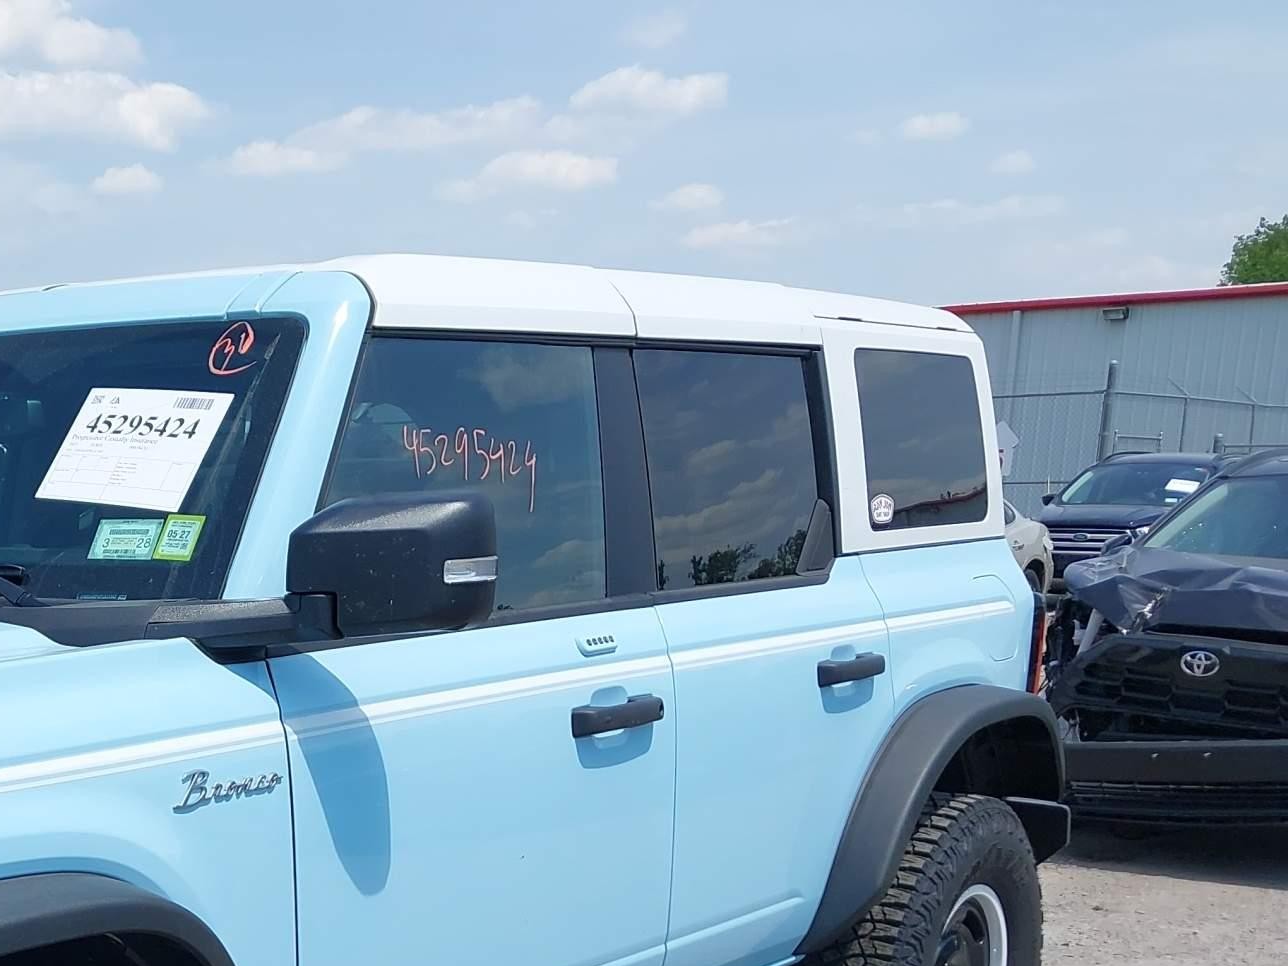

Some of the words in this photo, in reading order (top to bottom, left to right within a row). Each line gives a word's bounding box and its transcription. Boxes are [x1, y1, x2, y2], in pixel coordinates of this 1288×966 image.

[86, 413, 200, 439] 45295424
[404, 425, 536, 512] 45295424
[102, 537, 110, 548] 3
[136, 538, 152, 548] 28
[167, 529, 178, 539] 05
[179, 530, 191, 539] 27
[172, 769, 283, 814] Bronco
